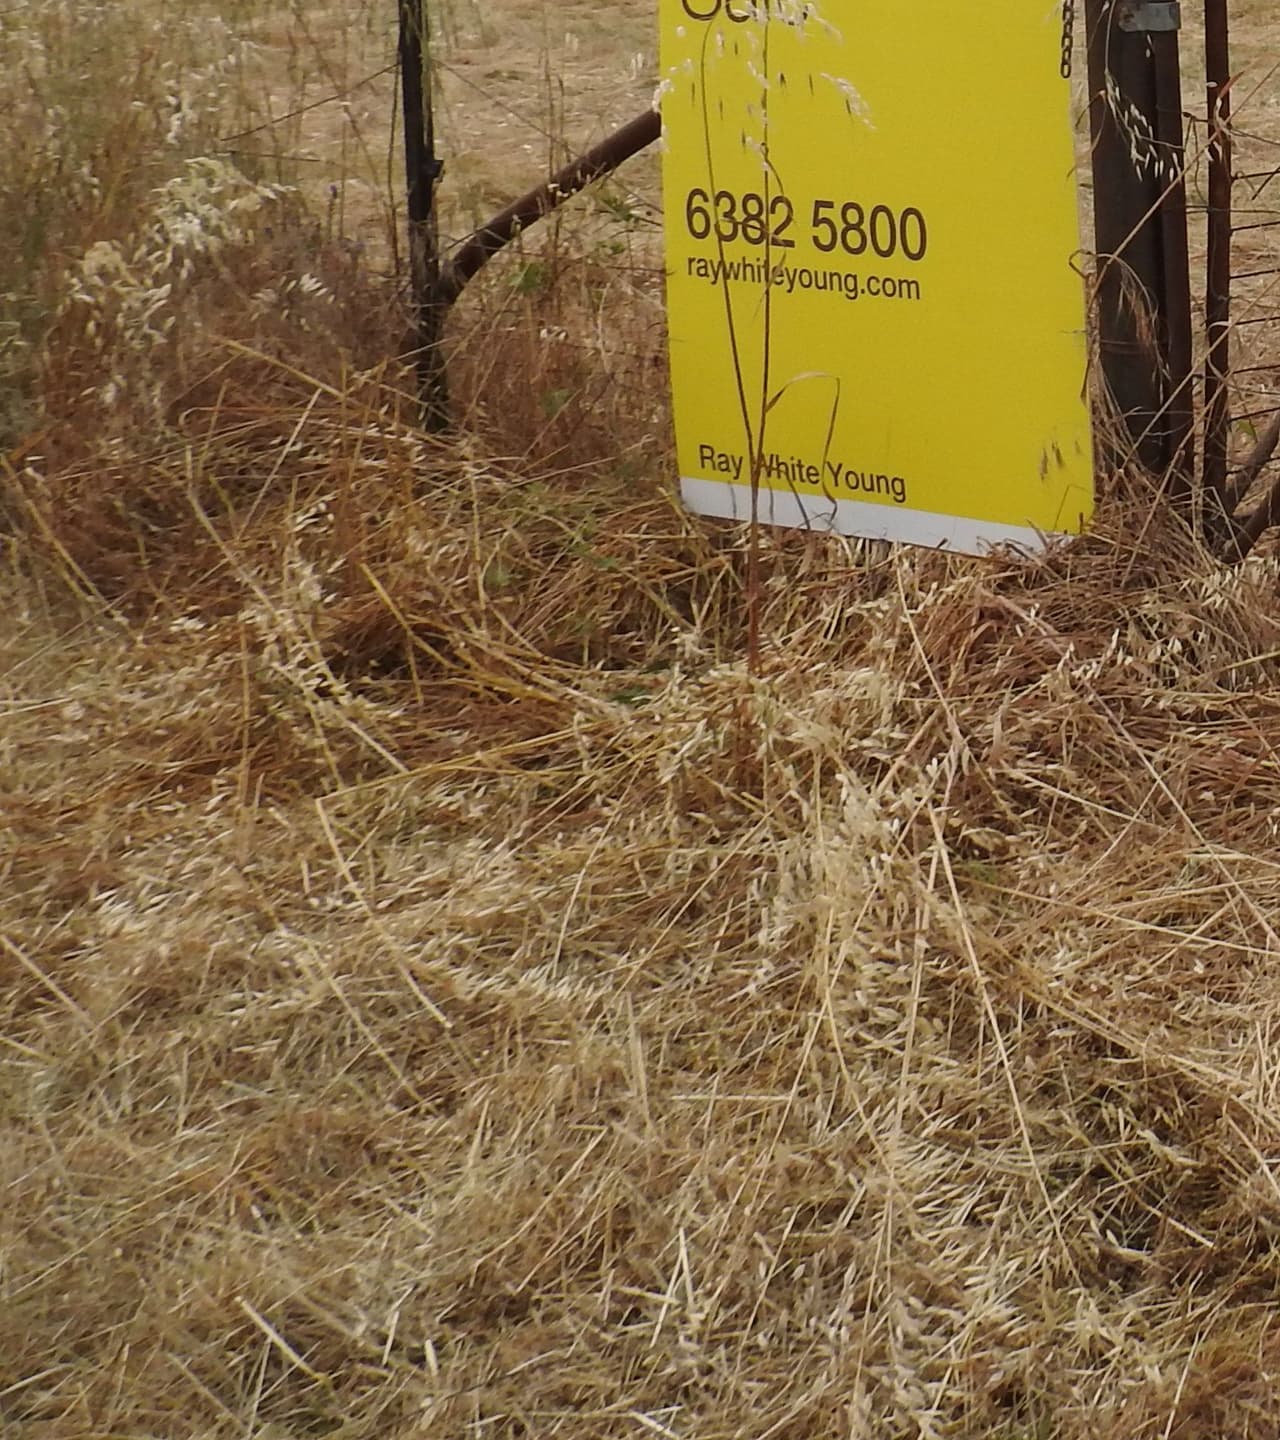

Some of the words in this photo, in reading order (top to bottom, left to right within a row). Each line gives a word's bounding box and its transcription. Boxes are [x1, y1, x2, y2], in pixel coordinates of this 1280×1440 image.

[686, 188, 796, 248] 6382
[812, 200, 928, 261] 5800
[687, 255, 921, 300] raywhiteyoung.com
[699, 444, 743, 480] Ray
[827, 461, 907, 504] Young
